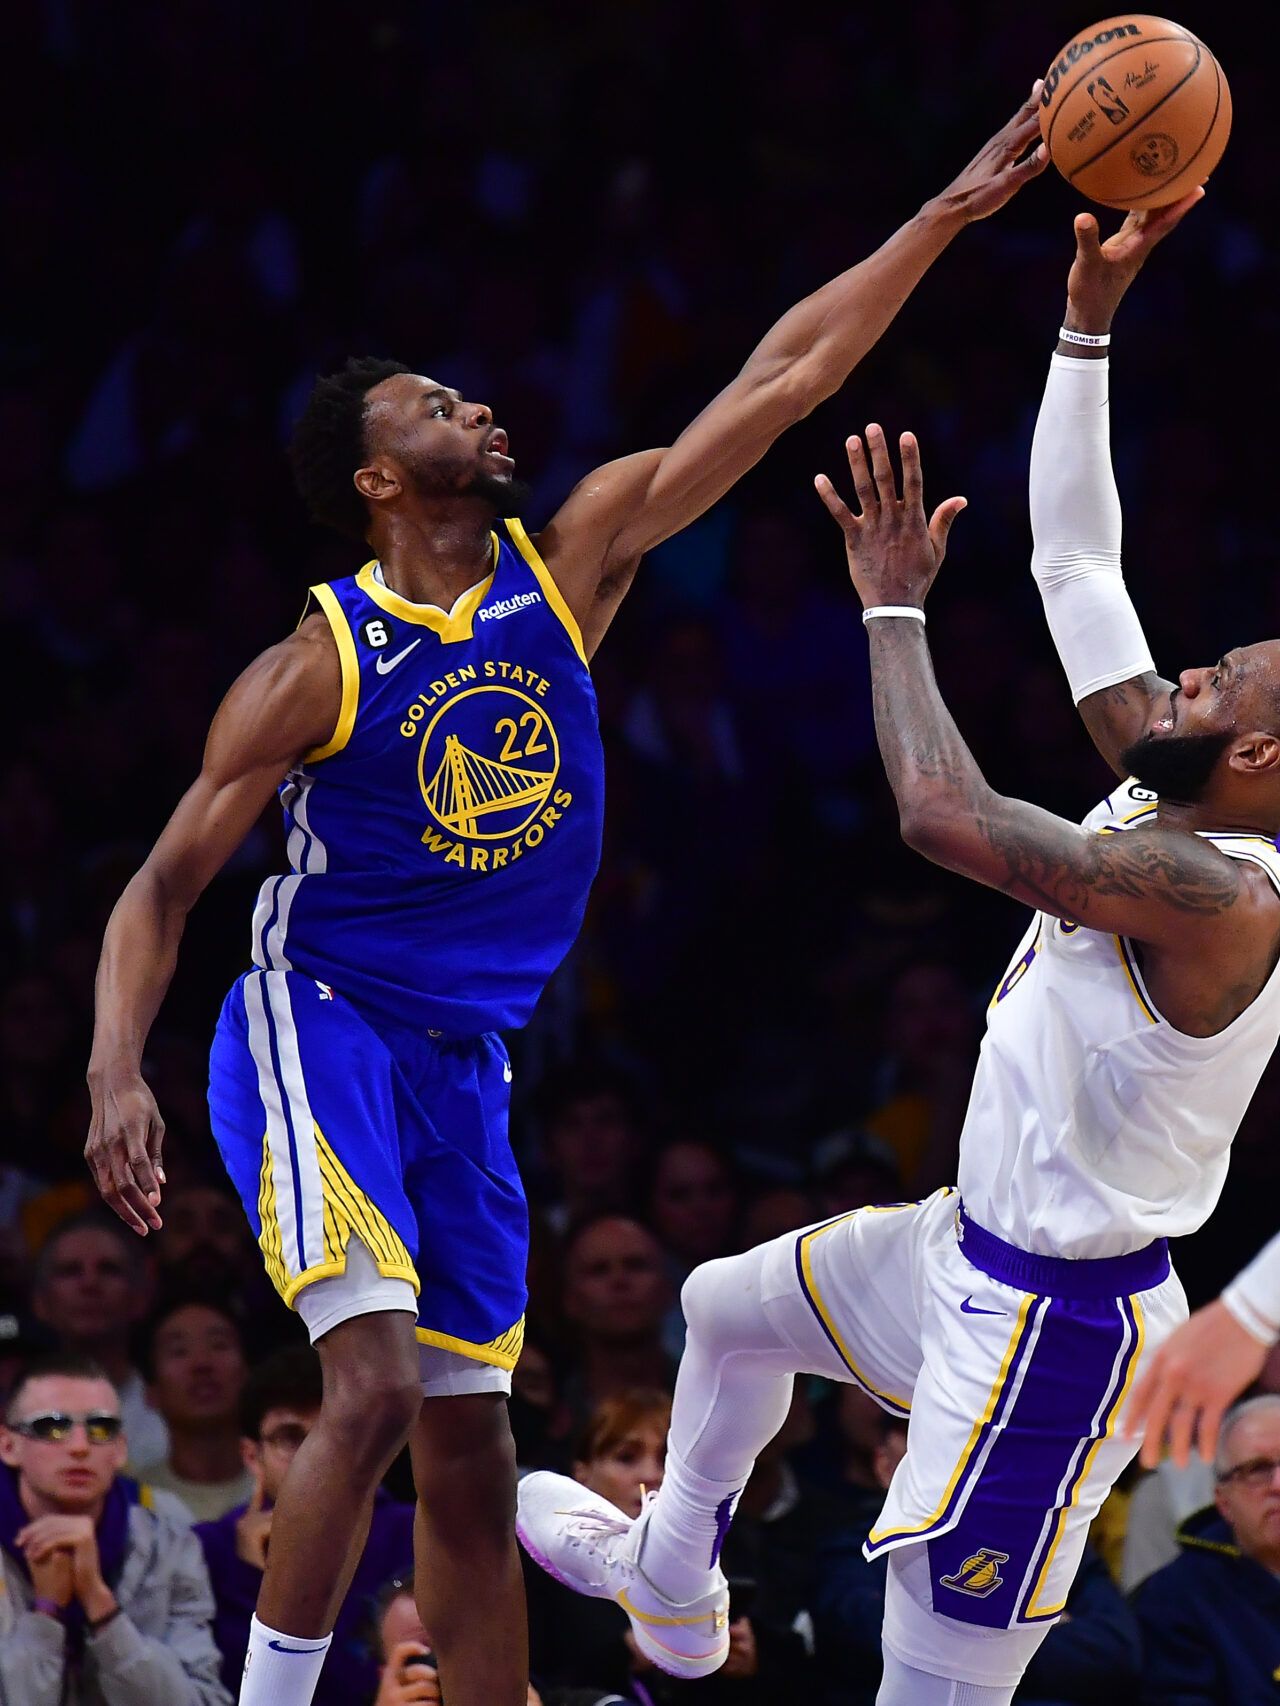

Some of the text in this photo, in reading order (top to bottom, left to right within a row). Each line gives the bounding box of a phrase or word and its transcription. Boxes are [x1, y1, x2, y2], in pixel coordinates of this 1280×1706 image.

[1066, 333, 1101, 345] PROMISE
[478, 591, 541, 622] Rakuten
[365, 620, 388, 647] 6
[400, 661, 551, 738] GOLDEN STATE
[494, 711, 548, 763] 22
[420, 788, 573, 872] WARRIORS
